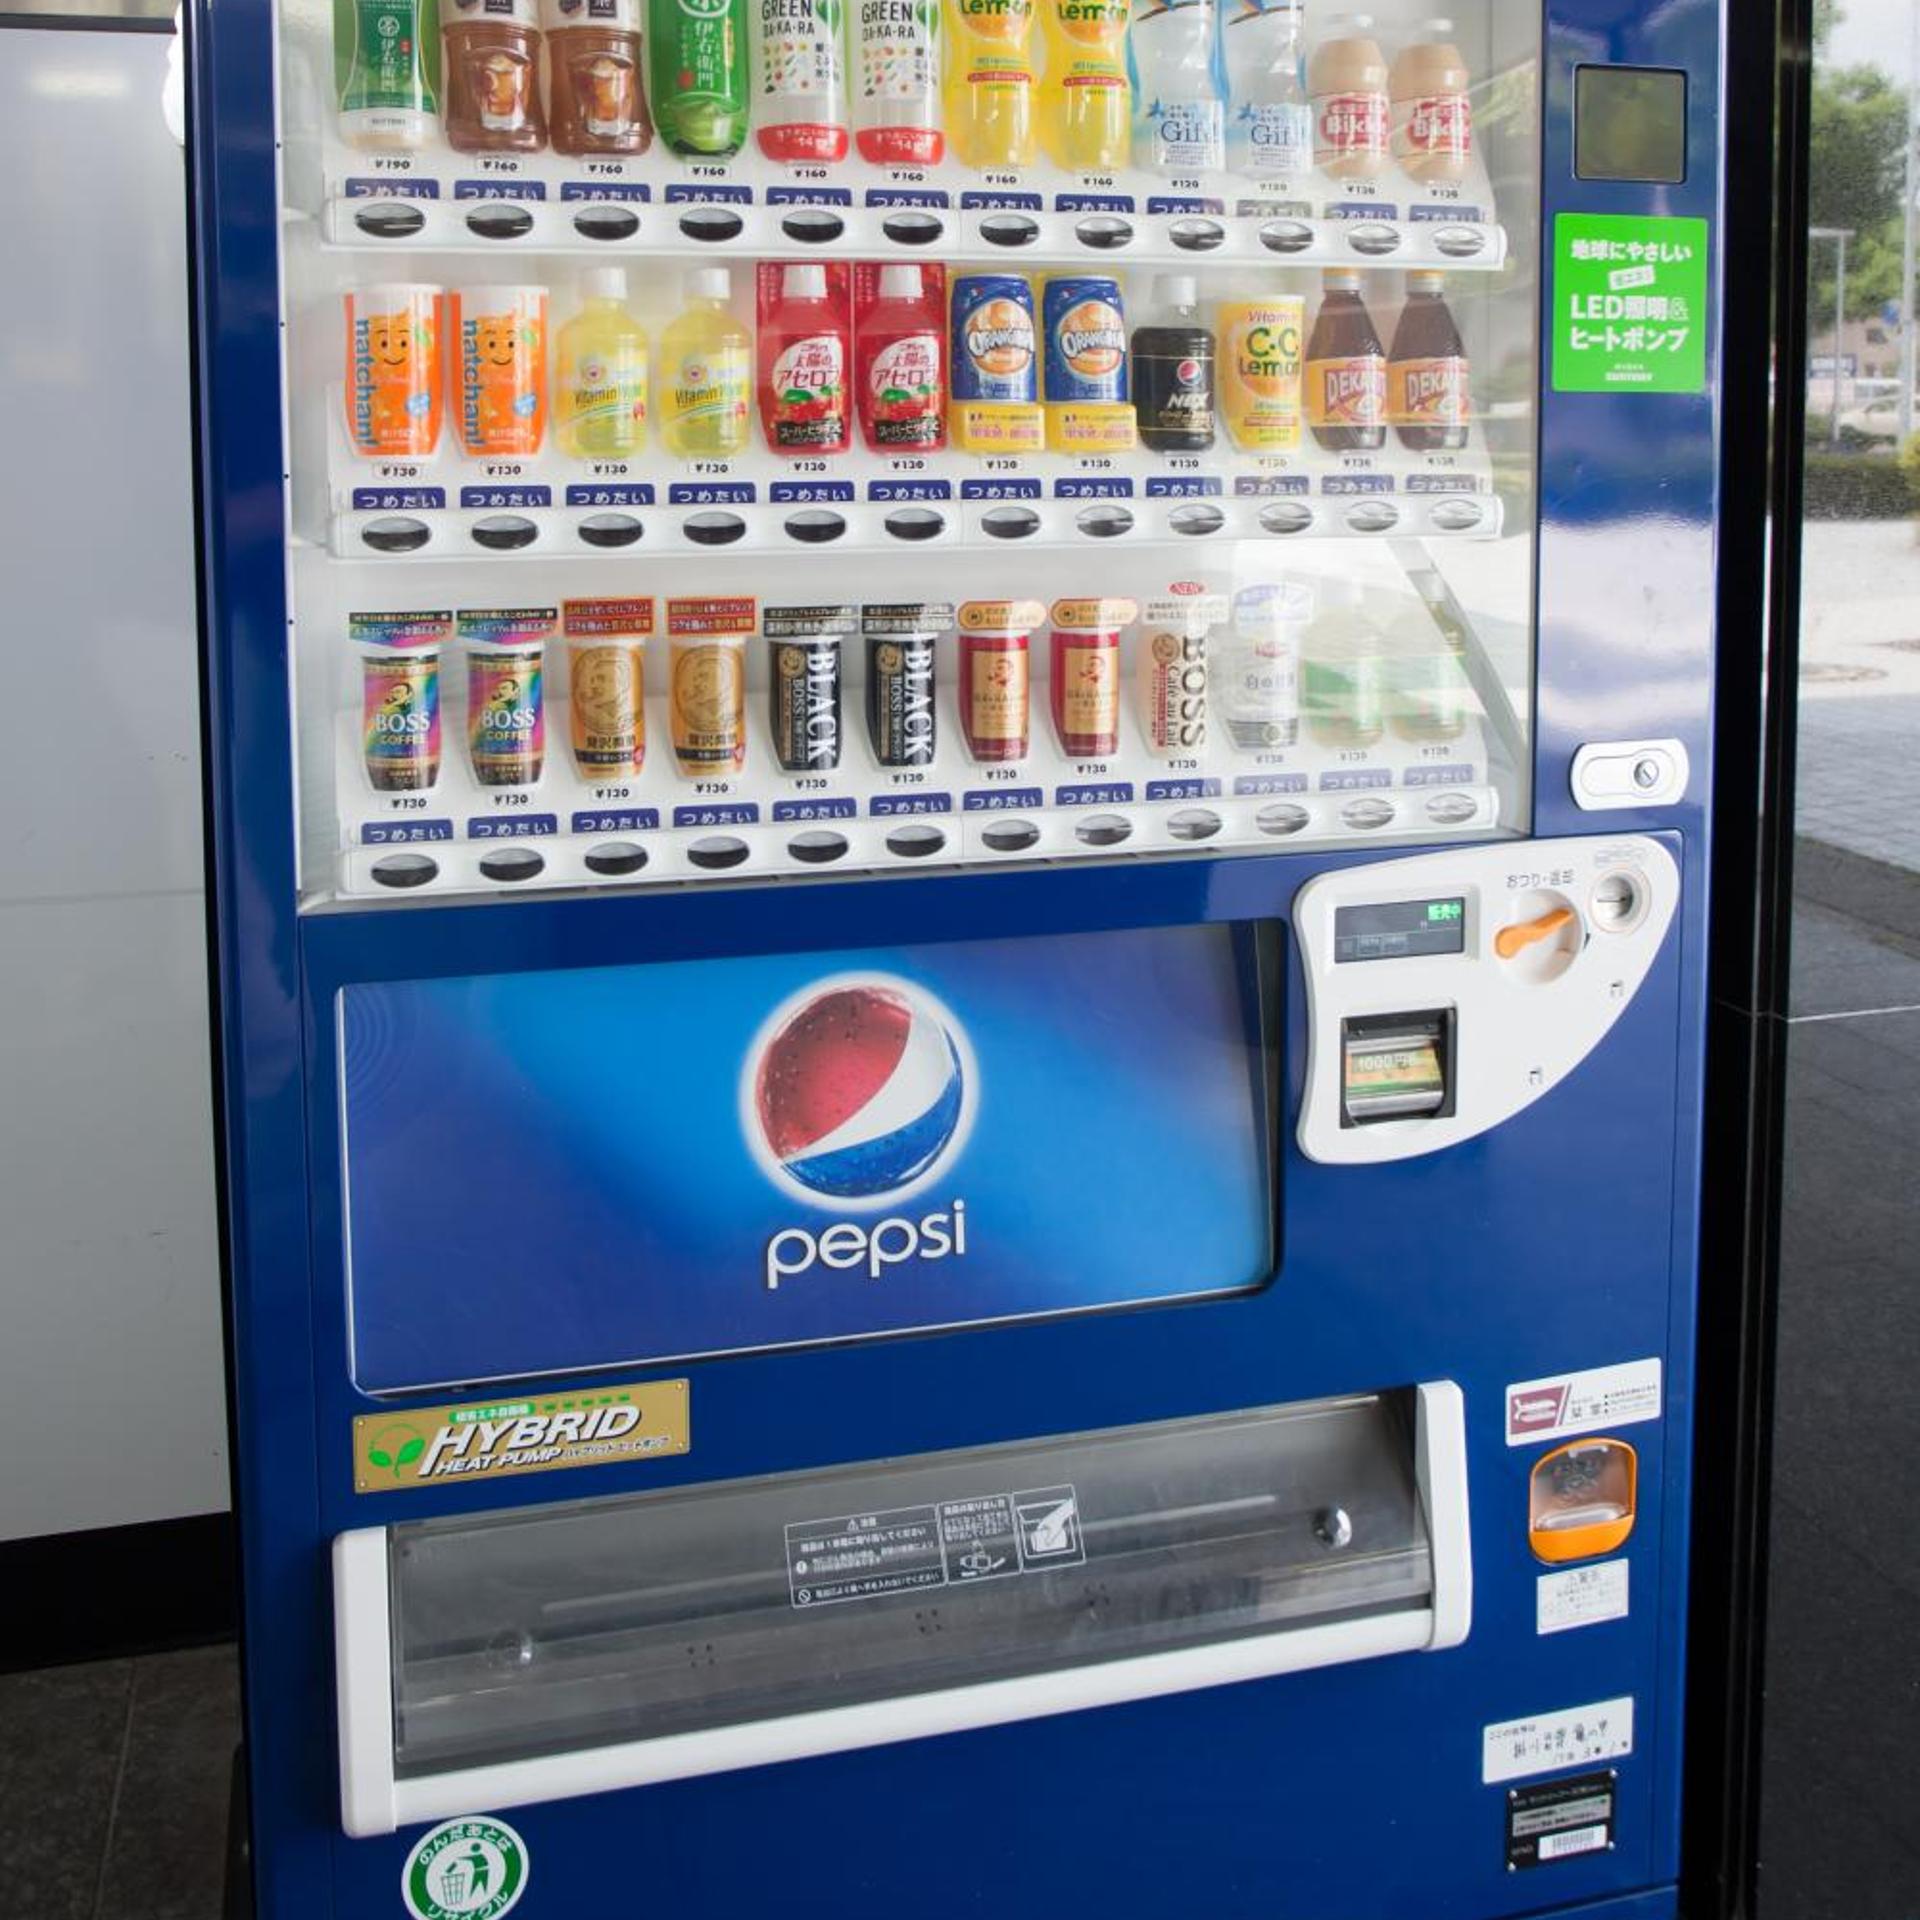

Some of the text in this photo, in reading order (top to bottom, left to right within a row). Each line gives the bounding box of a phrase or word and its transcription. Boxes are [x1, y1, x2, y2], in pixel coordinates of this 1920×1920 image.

[761, 0, 812, 21] GREEN
[861, 1, 913, 24] GREEN
[375, 160, 410, 170] ¥190
[483, 161, 517, 172] ¥160
[589, 164, 623, 174] ¥160
[692, 167, 725, 176] ¥160
[795, 169, 827, 178] ¥160
[892, 171, 923, 181] ¥160
[985, 175, 1017, 184] ¥160
[1083, 177, 1113, 186] ¥160
[354, 185, 431, 200] つめたい
[463, 186, 538, 201] つめたい
[570, 189, 643, 202] つめたい
[672, 191, 745, 205] つめたい
[775, 193, 845, 207] つめたい
[873, 195, 940, 209] つめたい
[968, 197, 1035, 211] つめたい
[1062, 199, 1128, 213] つめたい
[1154, 202, 1219, 215] つめたい
[1571, 239, 1692, 262] 地球にやさしい
[1571, 326, 1690, 352] ヒートポンプ
[356, 319, 379, 447] natchan!
[463, 319, 485, 447] natchan!
[487, 465, 521, 475] ¥130
[594, 464, 627, 474] ¥130
[695, 463, 728, 473] ¥130
[794, 462, 826, 471] ¥130
[892, 460, 924, 470] ¥130
[986, 460, 1017, 470] ¥130
[1081, 459, 1111, 469] ¥130
[381, 466, 416, 477] ¥130
[575, 491, 647, 505] つめたい
[677, 490, 749, 501] つめたい
[778, 489, 847, 501] つめたい
[876, 487, 943, 500] つめたい
[968, 486, 1035, 499] つめたい
[1062, 485, 1126, 498] つめたい
[1153, 484, 1215, 498] つめたい
[361, 494, 437, 508] つめたい
[469, 493, 544, 507] つめたい
[1181, 635, 1206, 747] BOSS
[791, 679, 805, 718] BOSS
[807, 650, 837, 761] BLACK
[904, 650, 933, 760] BLACK
[375, 712, 431, 733] BOSS
[481, 709, 536, 730] BOSS
[380, 732, 428, 745] COFFEE
[485, 729, 532, 742] COFFEE
[1077, 764, 1107, 774] ¥130
[1168, 759, 1197, 769] ¥130
[892, 773, 924, 783] ¥130
[987, 769, 1016, 779] ¥130
[695, 783, 728, 793] ¥130
[795, 779, 827, 789] ¥130
[494, 794, 528, 805] ¥130
[596, 788, 629, 798] ¥130
[1064, 790, 1126, 804] つめたい
[1153, 786, 1215, 799] つめたい
[391, 798, 427, 808] ¥130
[877, 800, 944, 814] つめたい
[971, 795, 1037, 809] つめたい
[681, 810, 751, 825] つめたい
[781, 806, 848, 820] つめたい
[477, 822, 550, 837] つめたい
[580, 816, 651, 832] つめたい
[370, 827, 445, 842] つめたい
[1428, 902, 1461, 920] 販売中
[766, 1198, 967, 1289] pepsi
[417, 1405, 642, 1476] HYBRID
[435, 1456, 500, 1475] HEAT
[501, 1446, 565, 1467] PUMP
[419, 1823, 512, 1865] のんだあとは
